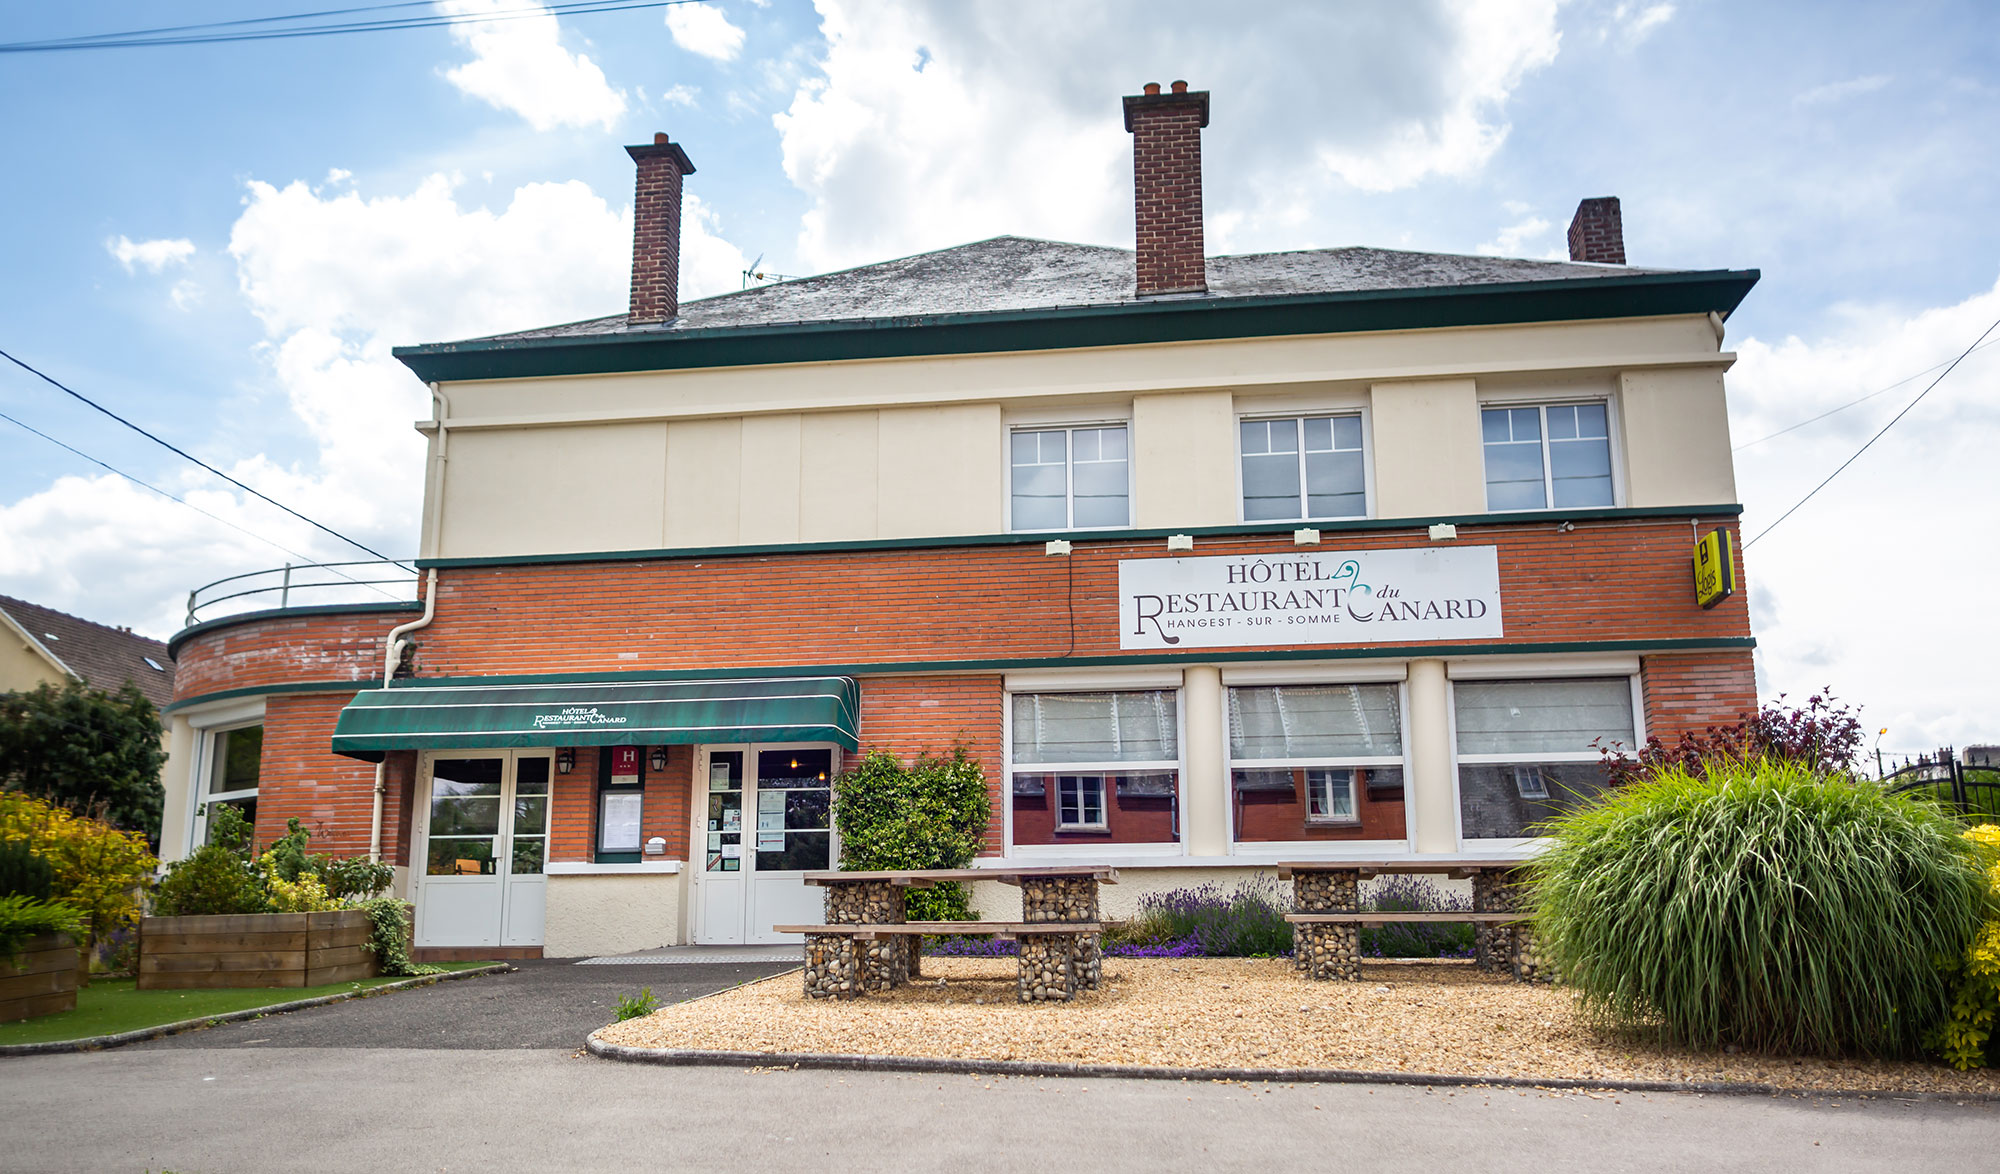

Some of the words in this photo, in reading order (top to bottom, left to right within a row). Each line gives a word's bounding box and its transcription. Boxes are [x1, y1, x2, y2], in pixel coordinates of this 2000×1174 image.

[1226, 558, 1330, 584] HÔTEL
[1697, 567, 1717, 598] Logis
[1376, 585, 1400, 599] du
[1347, 590, 1487, 623] CANARD
[1133, 588, 1346, 645] RESTAURANT
[1167, 618, 1232, 628] HANGEST
[1247, 617, 1272, 626] SUR
[1287, 614, 1340, 625] SOMME
[562, 707, 589, 715] HÔTEL
[533, 714, 591, 729] RESTAURANT
[623, 750, 635, 762] H
